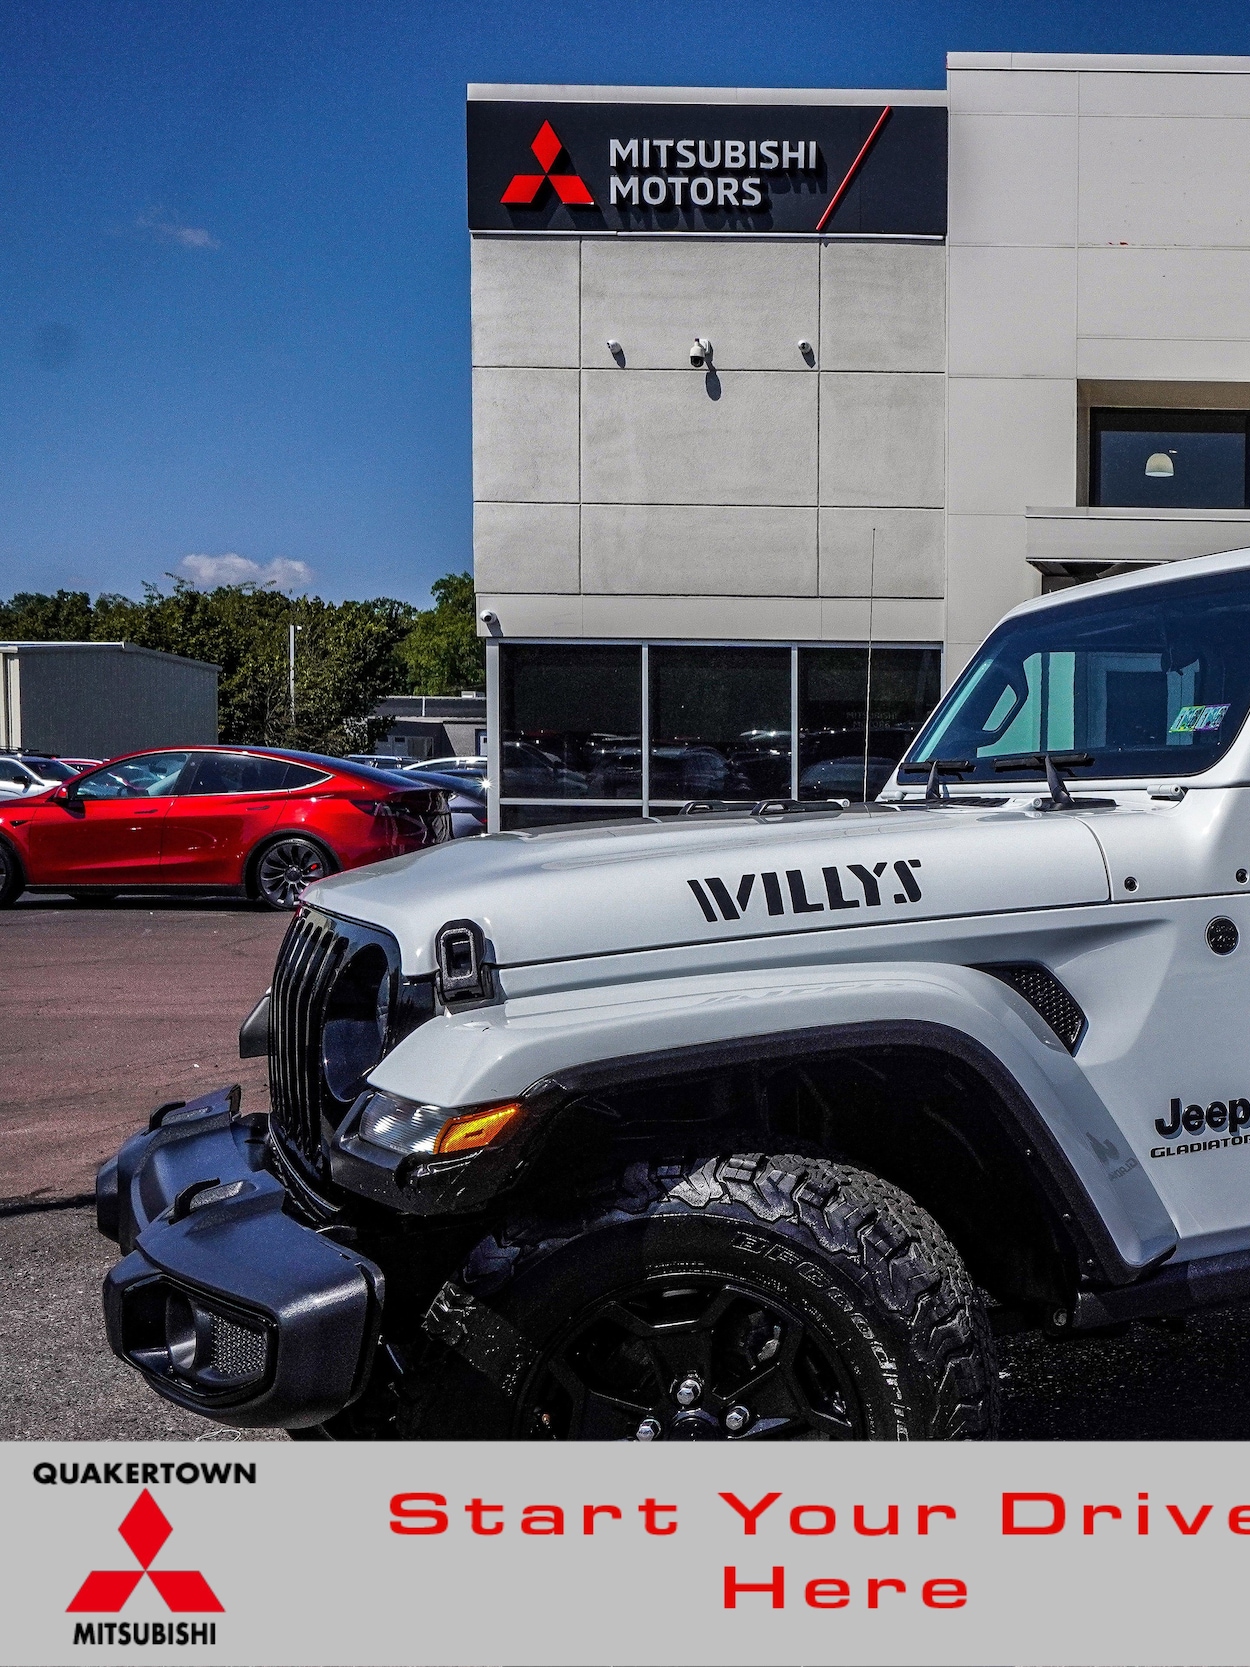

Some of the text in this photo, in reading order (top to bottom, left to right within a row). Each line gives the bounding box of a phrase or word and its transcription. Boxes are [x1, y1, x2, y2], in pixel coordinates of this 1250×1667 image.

[609, 138, 816, 170] MITSUBISHI
[609, 176, 763, 207] MOTORS
[687, 859, 922, 922] WILLYS
